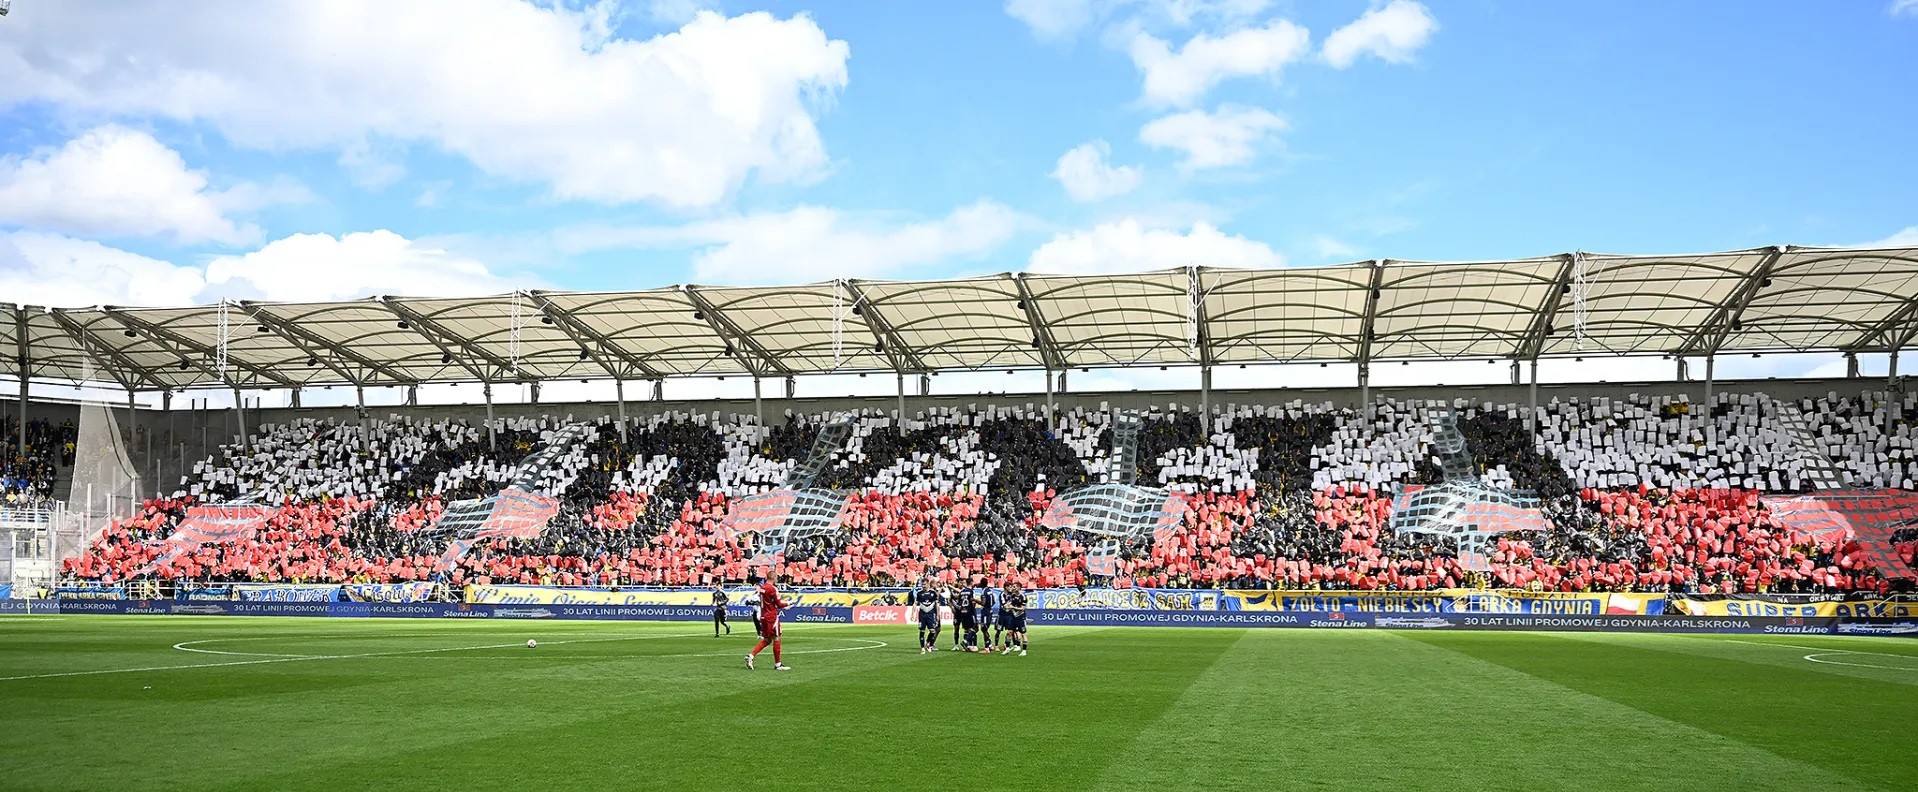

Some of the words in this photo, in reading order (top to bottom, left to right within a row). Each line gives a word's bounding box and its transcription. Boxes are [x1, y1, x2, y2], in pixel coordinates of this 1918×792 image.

[16, 602, 118, 611] GDYNIA-KARLSKRONA
[1155, 592, 1194, 611] SAM
[1357, 597, 1443, 613] NIEBIESCY
[1479, 596, 1522, 614] ARKA
[1531, 599, 1593, 615] GDYNIA
[233, 604, 245, 612] 30
[283, 605, 334, 613] PROMOWEJ
[336, 605, 434, 613] GDYNIA-KARLSKRONA
[563, 607, 574, 615] 30
[595, 608, 616, 616] LINII
[617, 608, 675, 616] PROMOWEJ
[859, 609, 898, 621] Betclic
[1041, 612, 1054, 620] 30
[1056, 613, 1077, 621] LAT
[1078, 613, 1102, 621] LINII
[1104, 614, 1170, 622] PROMOWEJ
[1172, 614, 1298, 623] GDYNIA-KARLSKRONA
[1309, 619, 1342, 628] Stena
[1343, 619, 1368, 628] Line
[1464, 617, 1479, 625] 30
[1481, 618, 1503, 626] LAT
[1505, 618, 1532, 626] LINII
[1535, 618, 1608, 627] PROMOWEJ
[1610, 619, 1750, 628] GDYNIA-KARLSKRONA
[1764, 625, 1801, 634] Stena
[1801, 625, 1829, 634] Line
